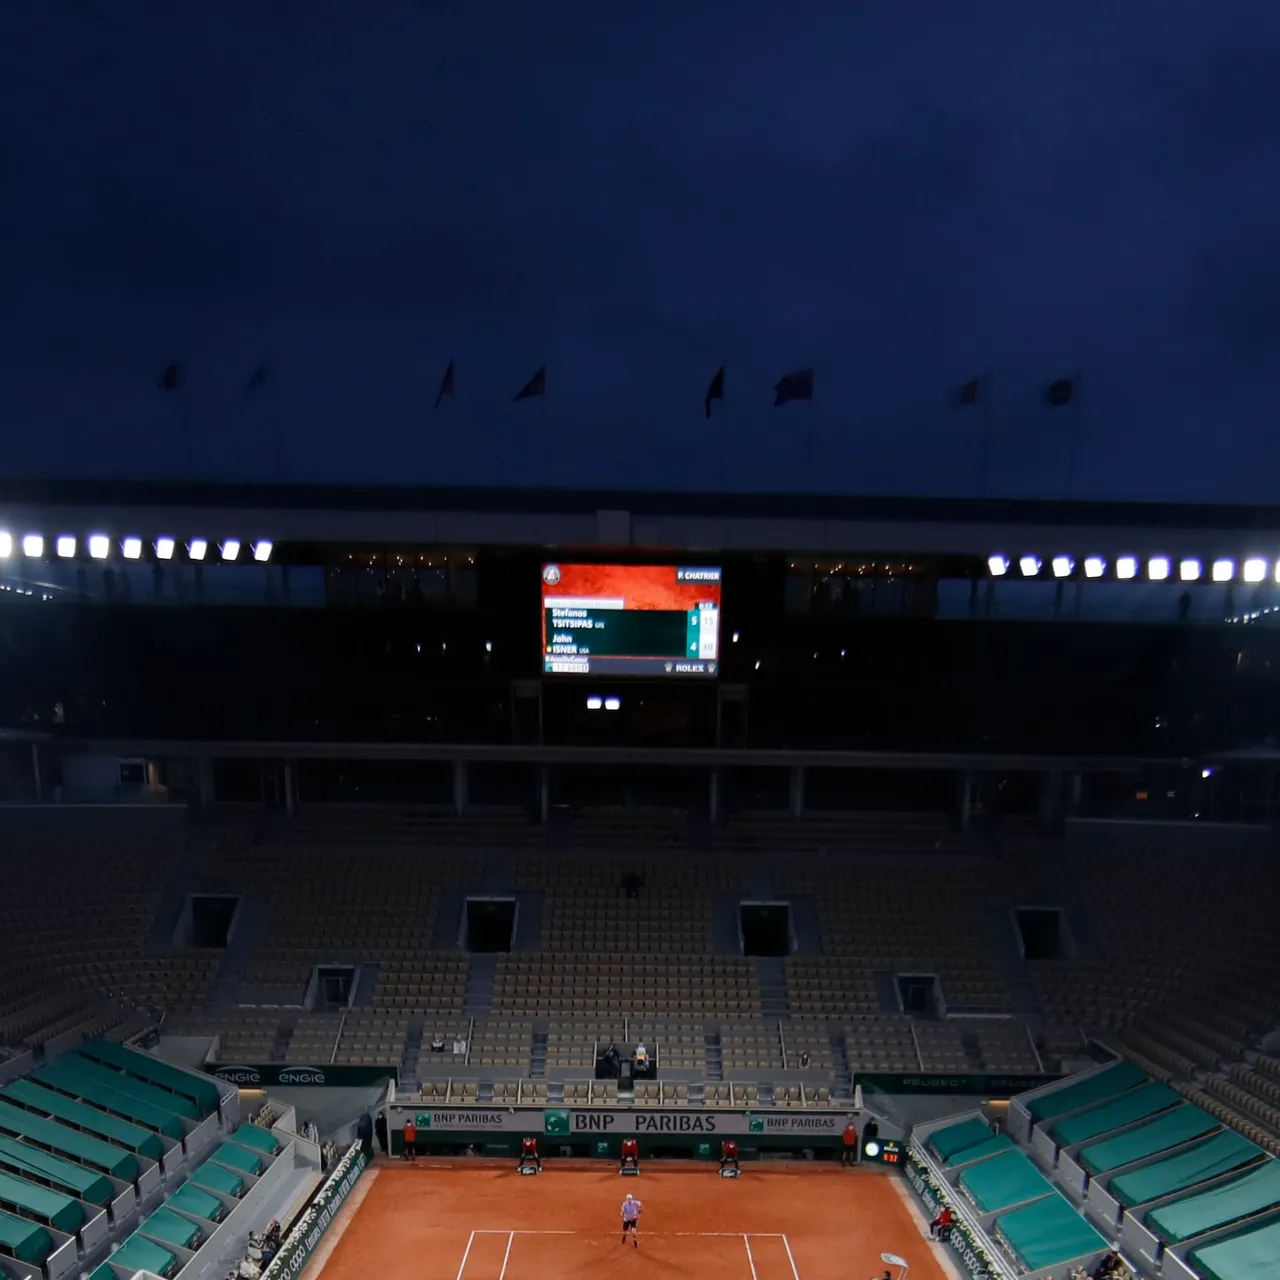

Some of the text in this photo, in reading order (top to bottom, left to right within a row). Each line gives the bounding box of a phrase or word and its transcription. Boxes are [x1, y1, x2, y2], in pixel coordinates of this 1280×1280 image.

[685, 571, 720, 580] CHATRIER
[552, 608, 588, 618] Stefanos
[552, 618, 593, 629] TSITSIPAS
[552, 633, 573, 643] John
[552, 645, 578, 654] ISNER
[675, 664, 705, 672] ROLEX
[433, 1113, 503, 1124] BNP PARIBAS
[575, 1114, 716, 1132] BNP PARIBAS
[767, 1117, 835, 1128] BNP PARIBAS
[950, 1228, 966, 1253] oppo
[289, 1245, 306, 1272] oppo
